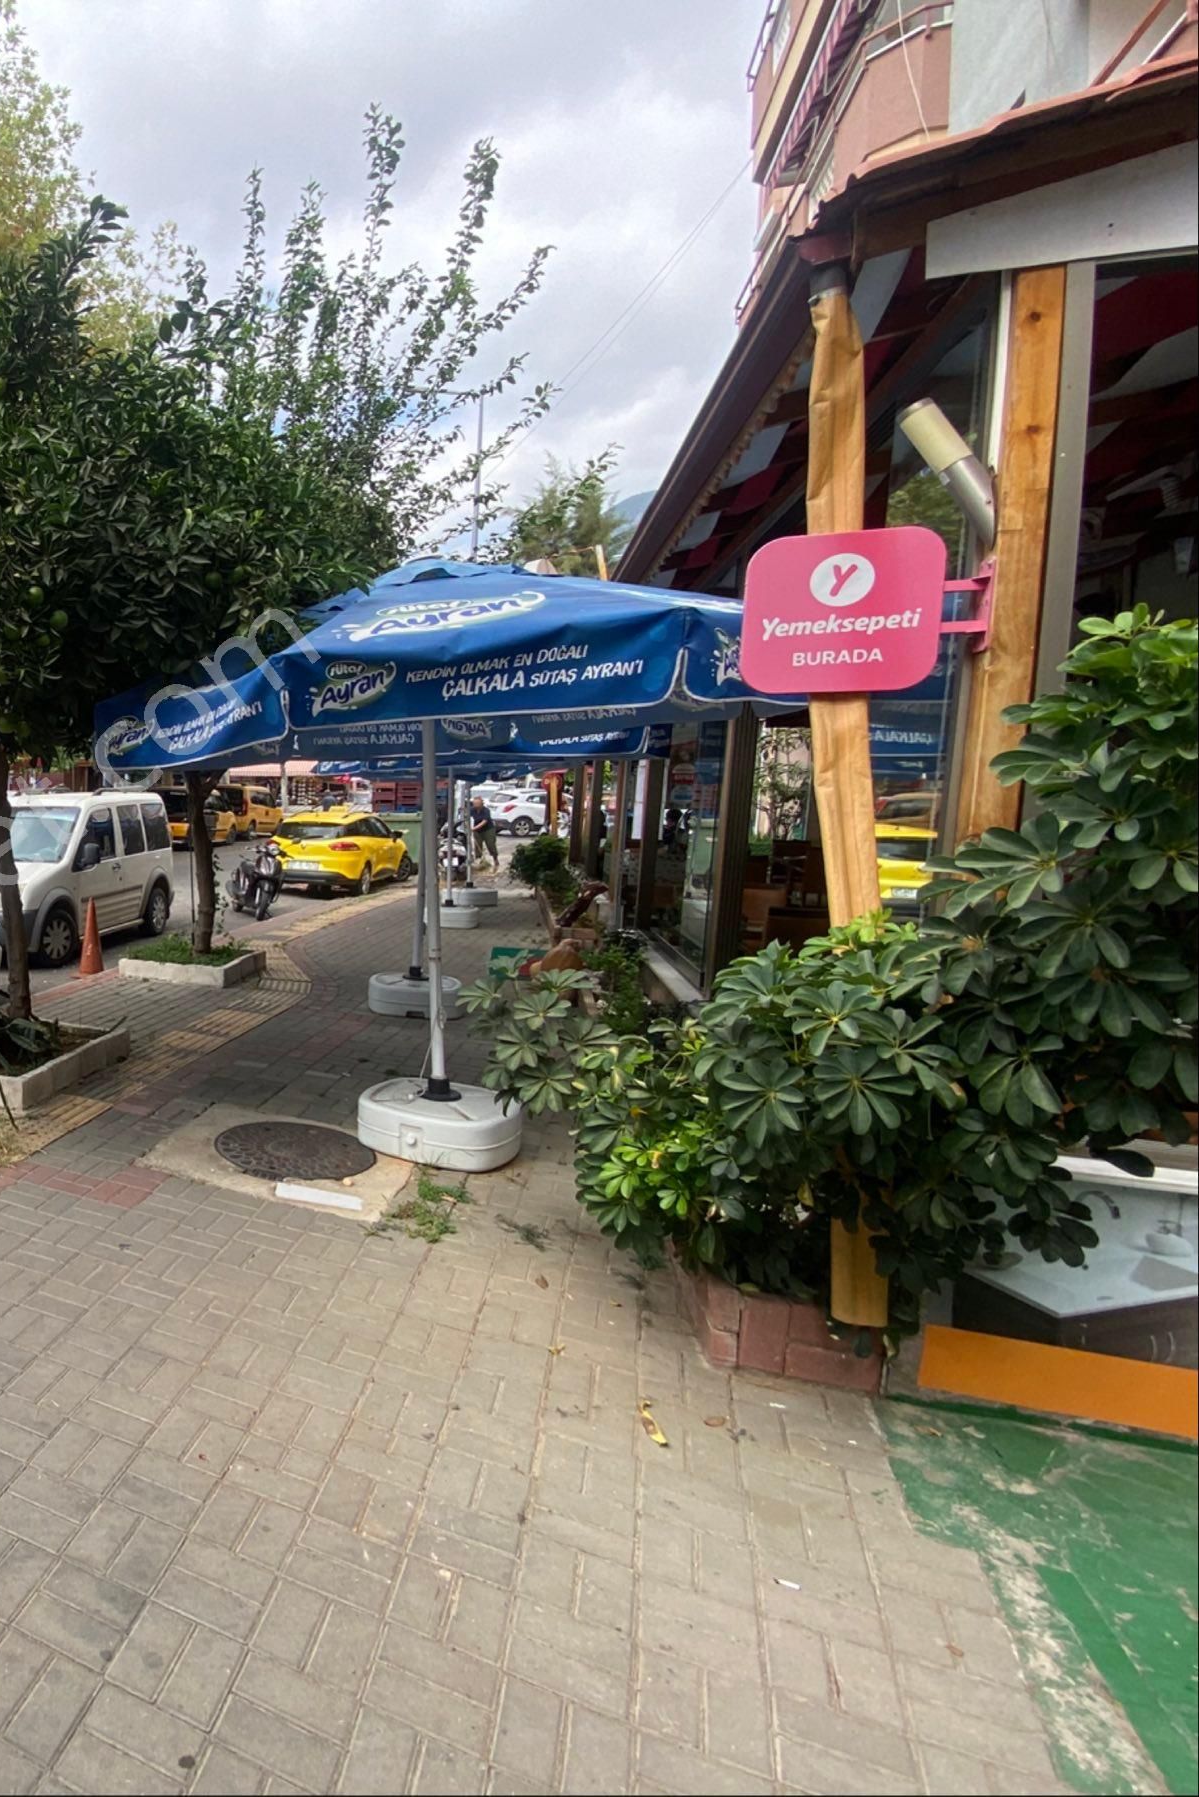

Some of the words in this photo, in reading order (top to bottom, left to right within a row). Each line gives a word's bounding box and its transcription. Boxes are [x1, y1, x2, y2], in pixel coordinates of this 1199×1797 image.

[370, 598, 522, 635] Ayran
[762, 607, 922, 641] Yemeksepeti
[460, 655, 511, 675] OLMAK
[513, 652, 534, 667] EN
[536, 644, 589, 665] DOĞALI
[792, 648, 884, 667] BURADA
[320, 670, 385, 708] Ayran
[442, 669, 525, 702] ÇALKALA
[529, 667, 579, 687] SÜTAŞ
